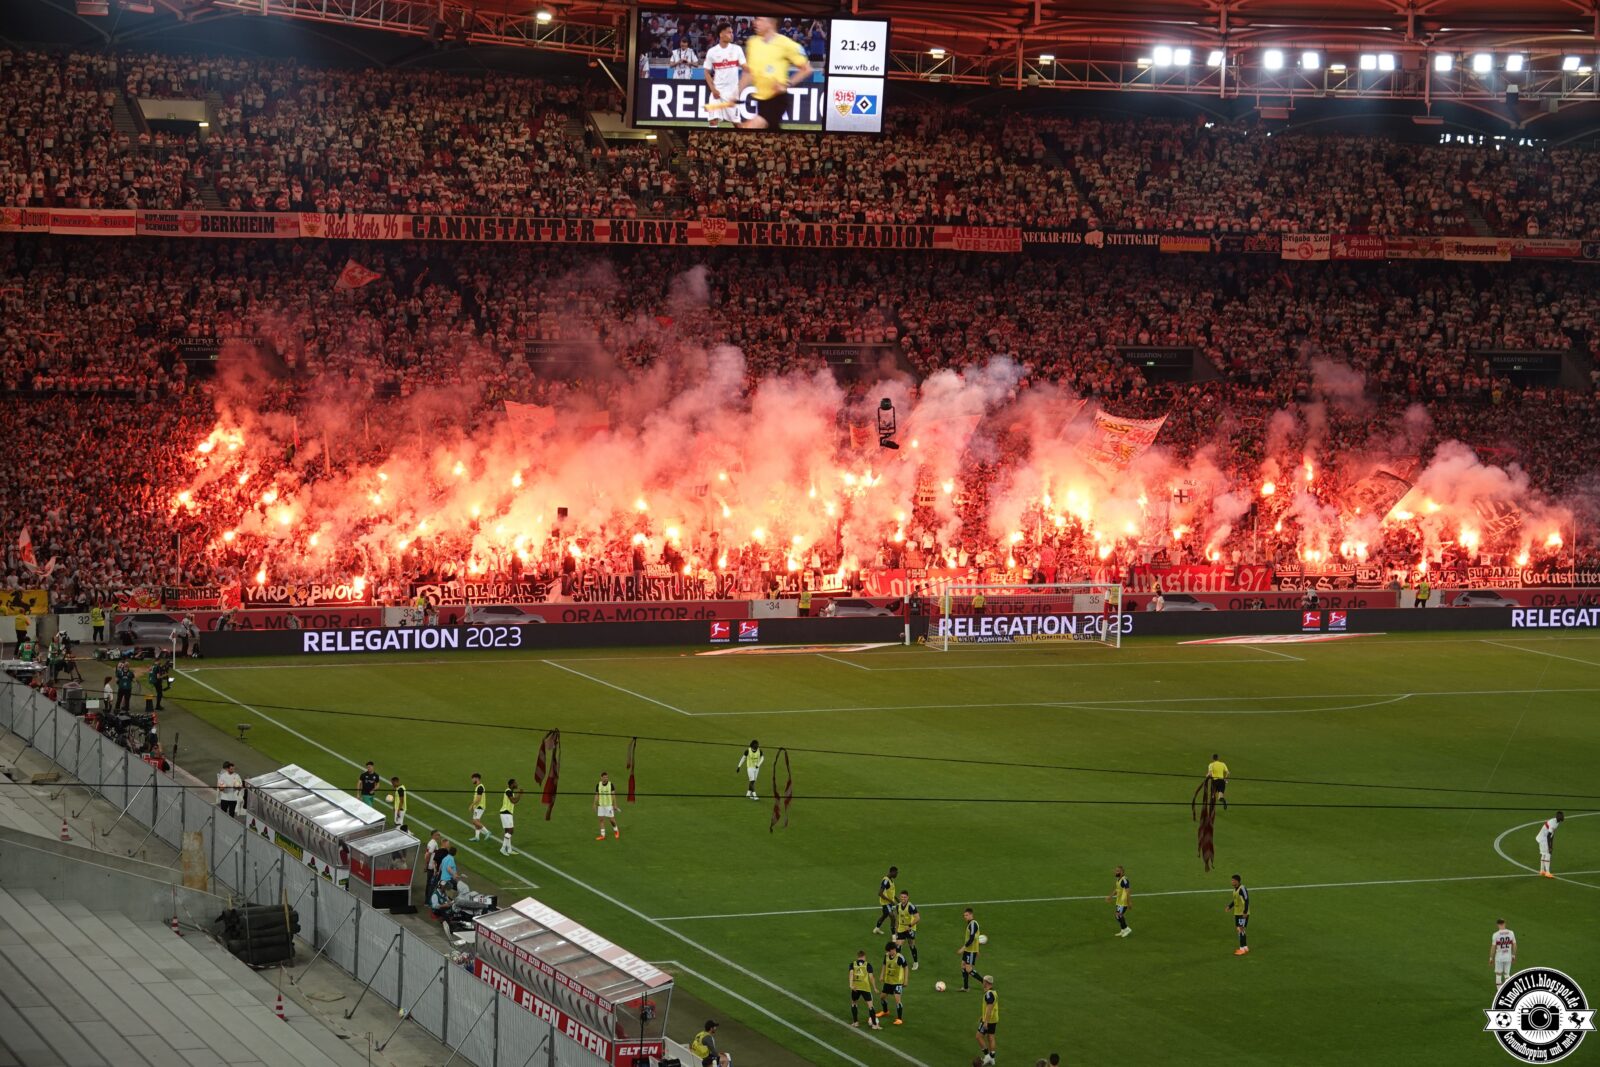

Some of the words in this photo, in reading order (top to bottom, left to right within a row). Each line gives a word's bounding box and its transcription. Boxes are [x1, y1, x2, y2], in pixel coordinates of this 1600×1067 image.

[840, 40, 876, 52] 21:49
[834, 63, 880, 72] www.vfb.de
[201, 216, 275, 234] BERKHEIM
[324, 213, 349, 237] Red
[352, 213, 380, 237] Hots
[384, 214, 398, 238] 96
[412, 216, 595, 242] CANNSTATTER
[610, 220, 688, 243] KURVE
[955, 227, 1021, 238] ALBSTADT
[738, 223, 935, 248] NECKARSTADION
[1022, 231, 1081, 244] NECKAR-FILS
[1107, 233, 1159, 246] STUTTGART
[956, 239, 1021, 251] VFB-FANS
[246, 586, 288, 603] YARD
[78, 616, 89, 625] 32
[562, 606, 716, 622] ORA-MOTOR.de
[1512, 609, 1600, 627] RELEGAT
[938, 616, 1077, 637] RELEGATION
[1083, 615, 1133, 636] 2023
[303, 630, 459, 652] RELEGATION
[466, 627, 521, 648] 2023
[1500, 937, 1510, 949] 22
[480, 965, 516, 1002] ELTEN
[522, 990, 560, 1028] ELTEN
[566, 1019, 608, 1058] ELTEN
[618, 1046, 659, 1057] ELTEN
